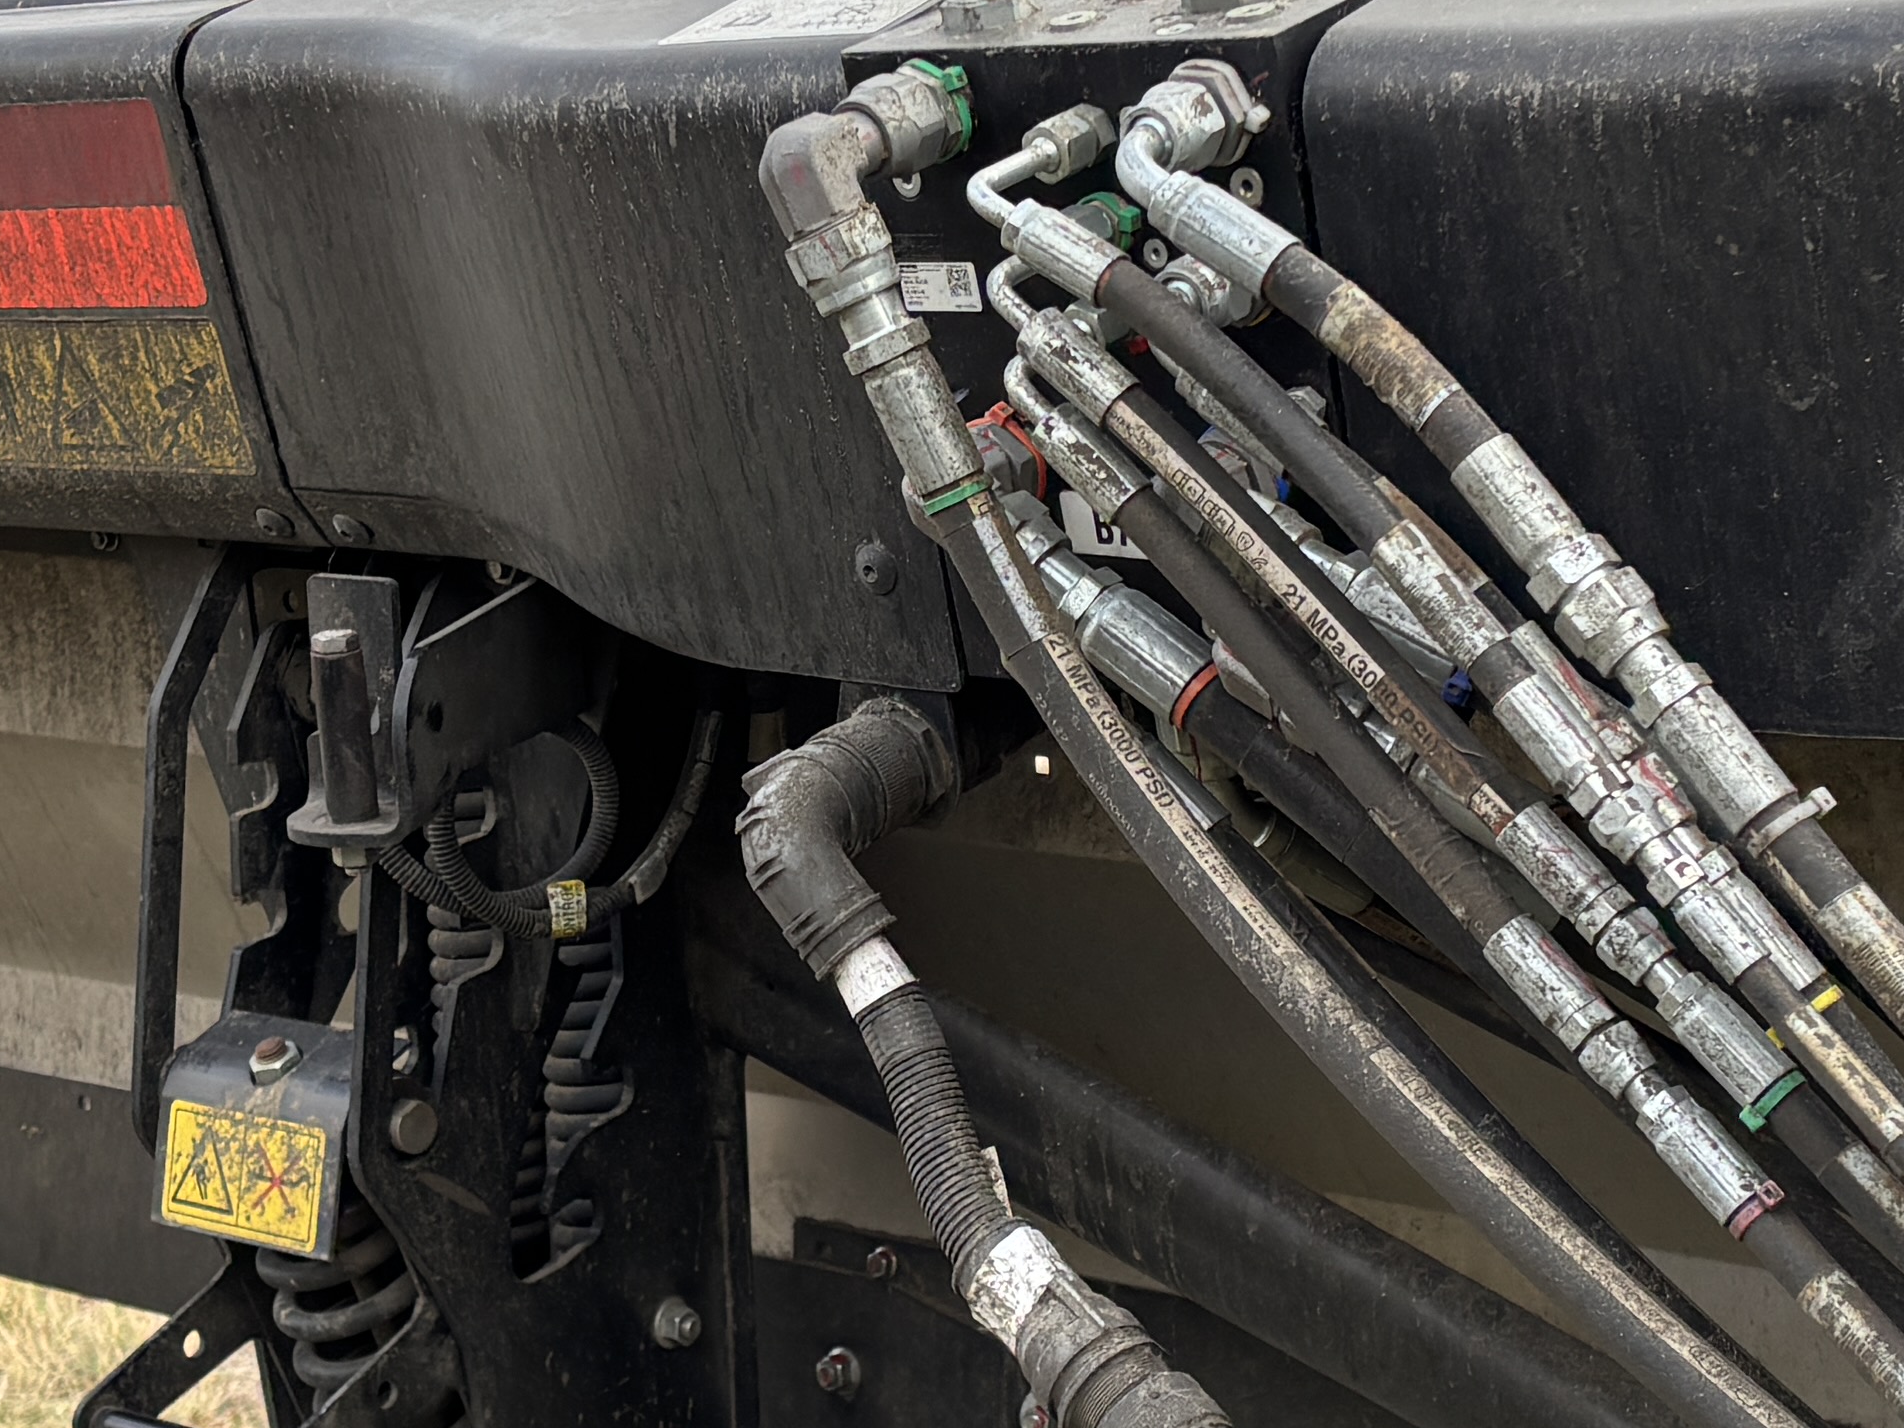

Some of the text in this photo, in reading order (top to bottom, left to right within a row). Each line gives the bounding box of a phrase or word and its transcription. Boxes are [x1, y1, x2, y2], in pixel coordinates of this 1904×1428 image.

[1280, 583, 1308, 612] 21
[1306, 607, 1346, 657] MPa
[1049, 635, 1069, 661] 21
[1066, 664, 1100, 708] MPa
[1096, 709, 1142, 764] (3000
[1134, 766, 1175, 808] PSI)
